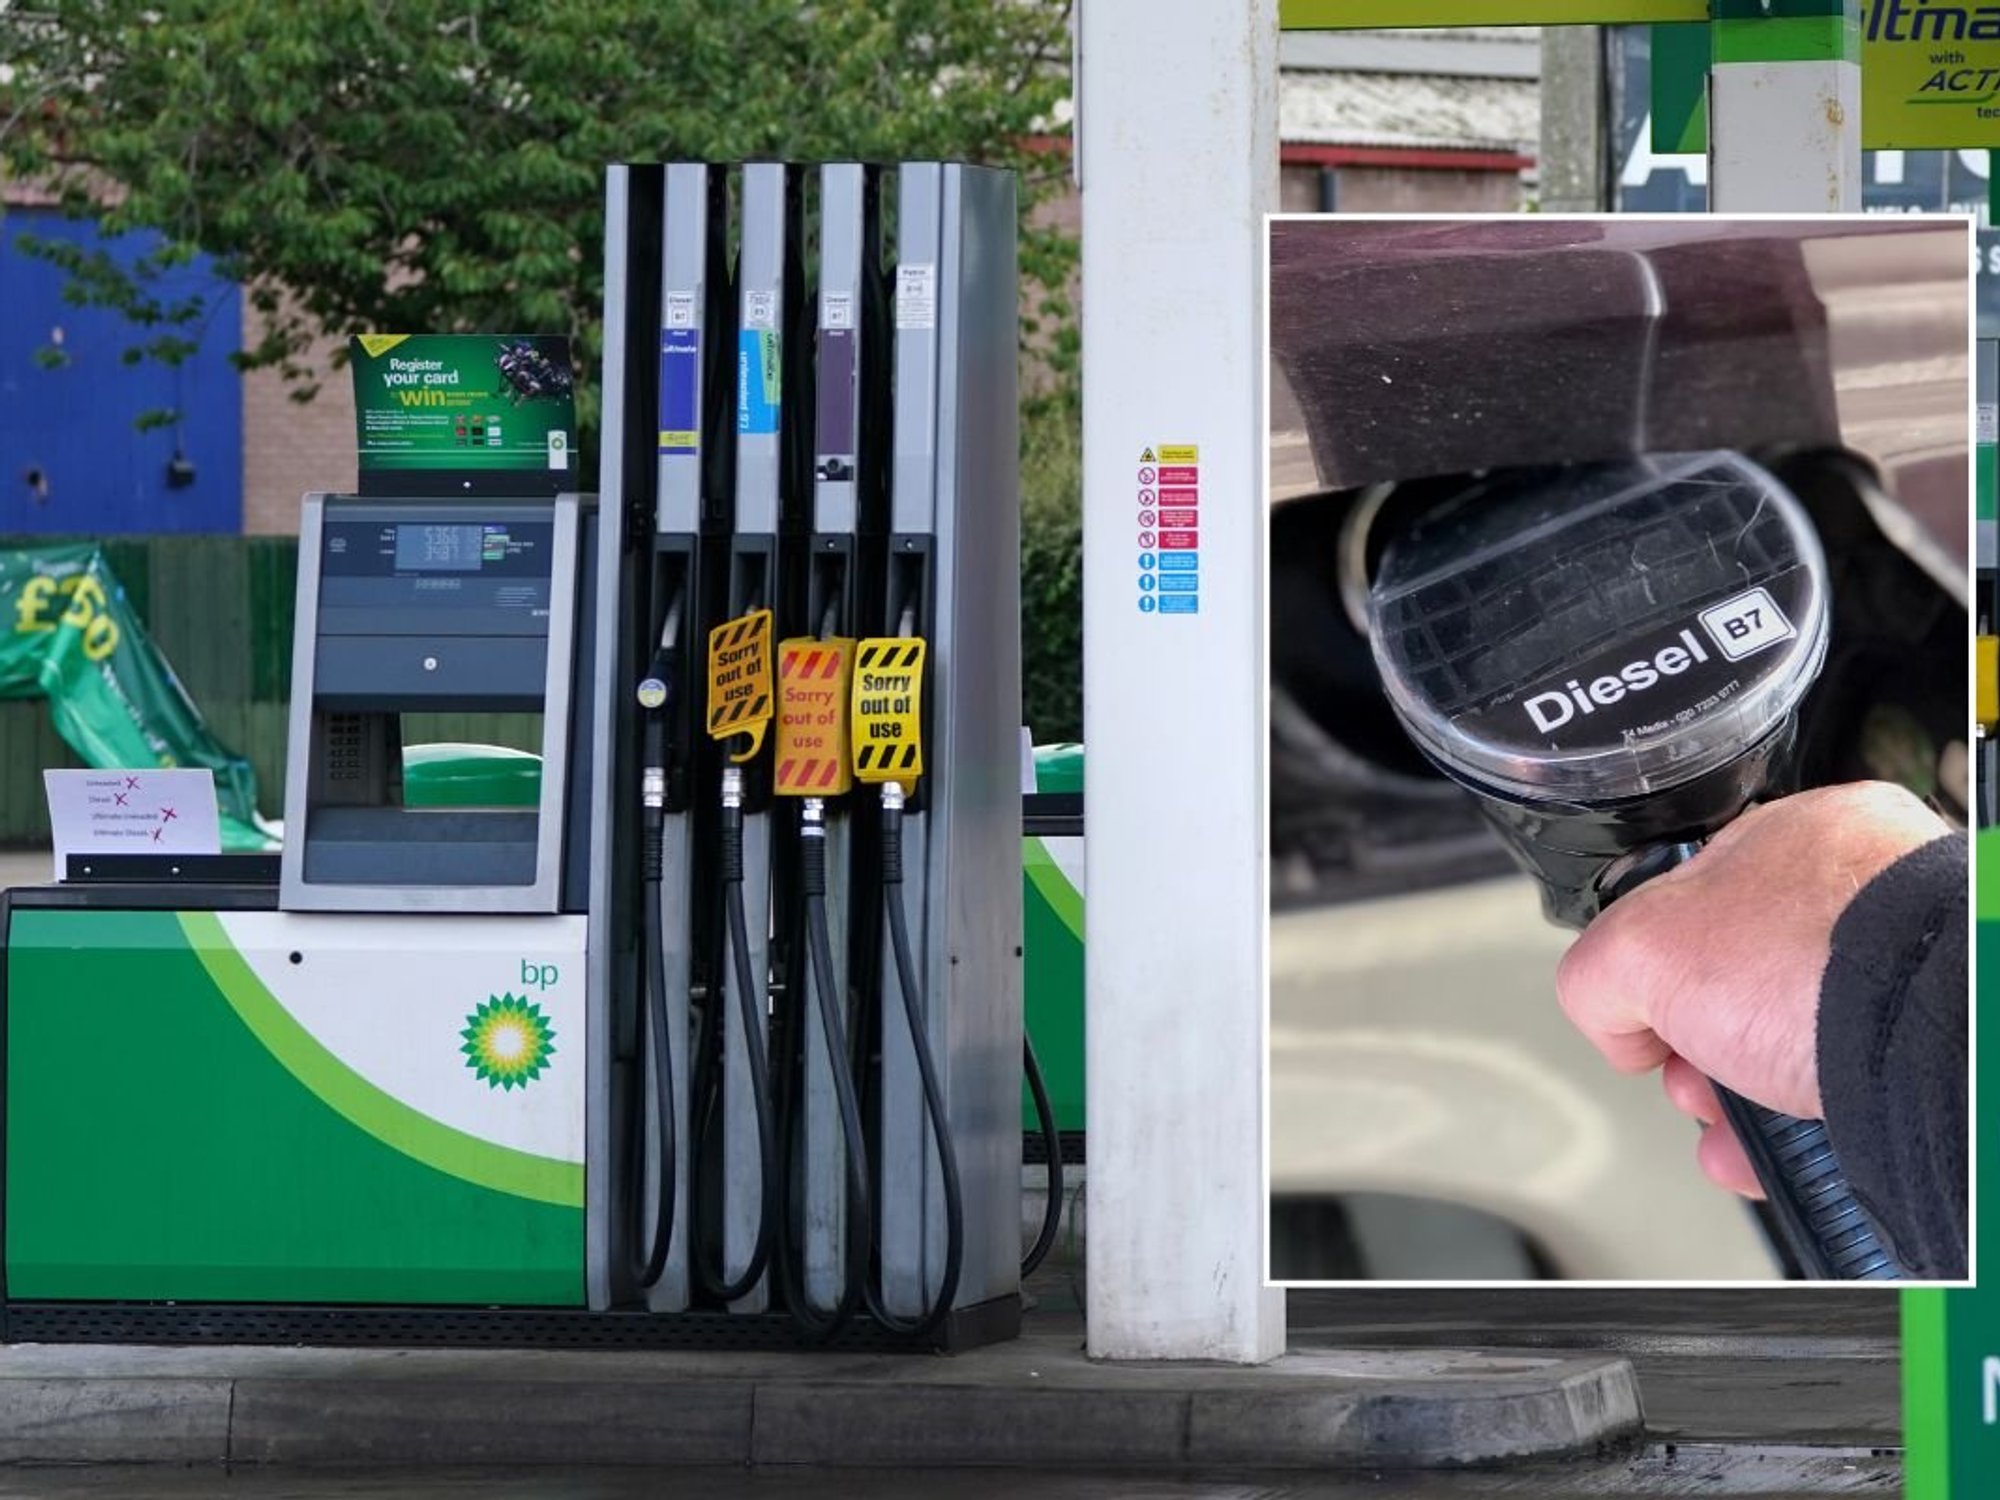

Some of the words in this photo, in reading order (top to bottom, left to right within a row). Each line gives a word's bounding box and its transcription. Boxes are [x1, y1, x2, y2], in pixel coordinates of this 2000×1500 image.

[1861, 0, 2000, 41] ltima
[1930, 51, 1964, 64] with
[390, 358, 443, 372] Register
[383, 372, 420, 388] your
[424, 370, 459, 385] card
[401, 386, 446, 406] win
[1723, 608, 1763, 639] B7
[718, 640, 760, 667] Sorry
[716, 668, 741, 686] out
[746, 660, 762, 676] of
[863, 673, 911, 692] Sorry
[1523, 629, 1709, 734] Diesel
[724, 683, 754, 702] use
[785, 688, 834, 706] Sorry
[860, 700, 890, 716] out
[894, 696, 910, 714] of
[783, 713, 812, 726] out
[820, 710, 836, 725] of
[870, 722, 902, 738] use
[793, 736, 823, 748] use
[521, 958, 558, 991] bp
